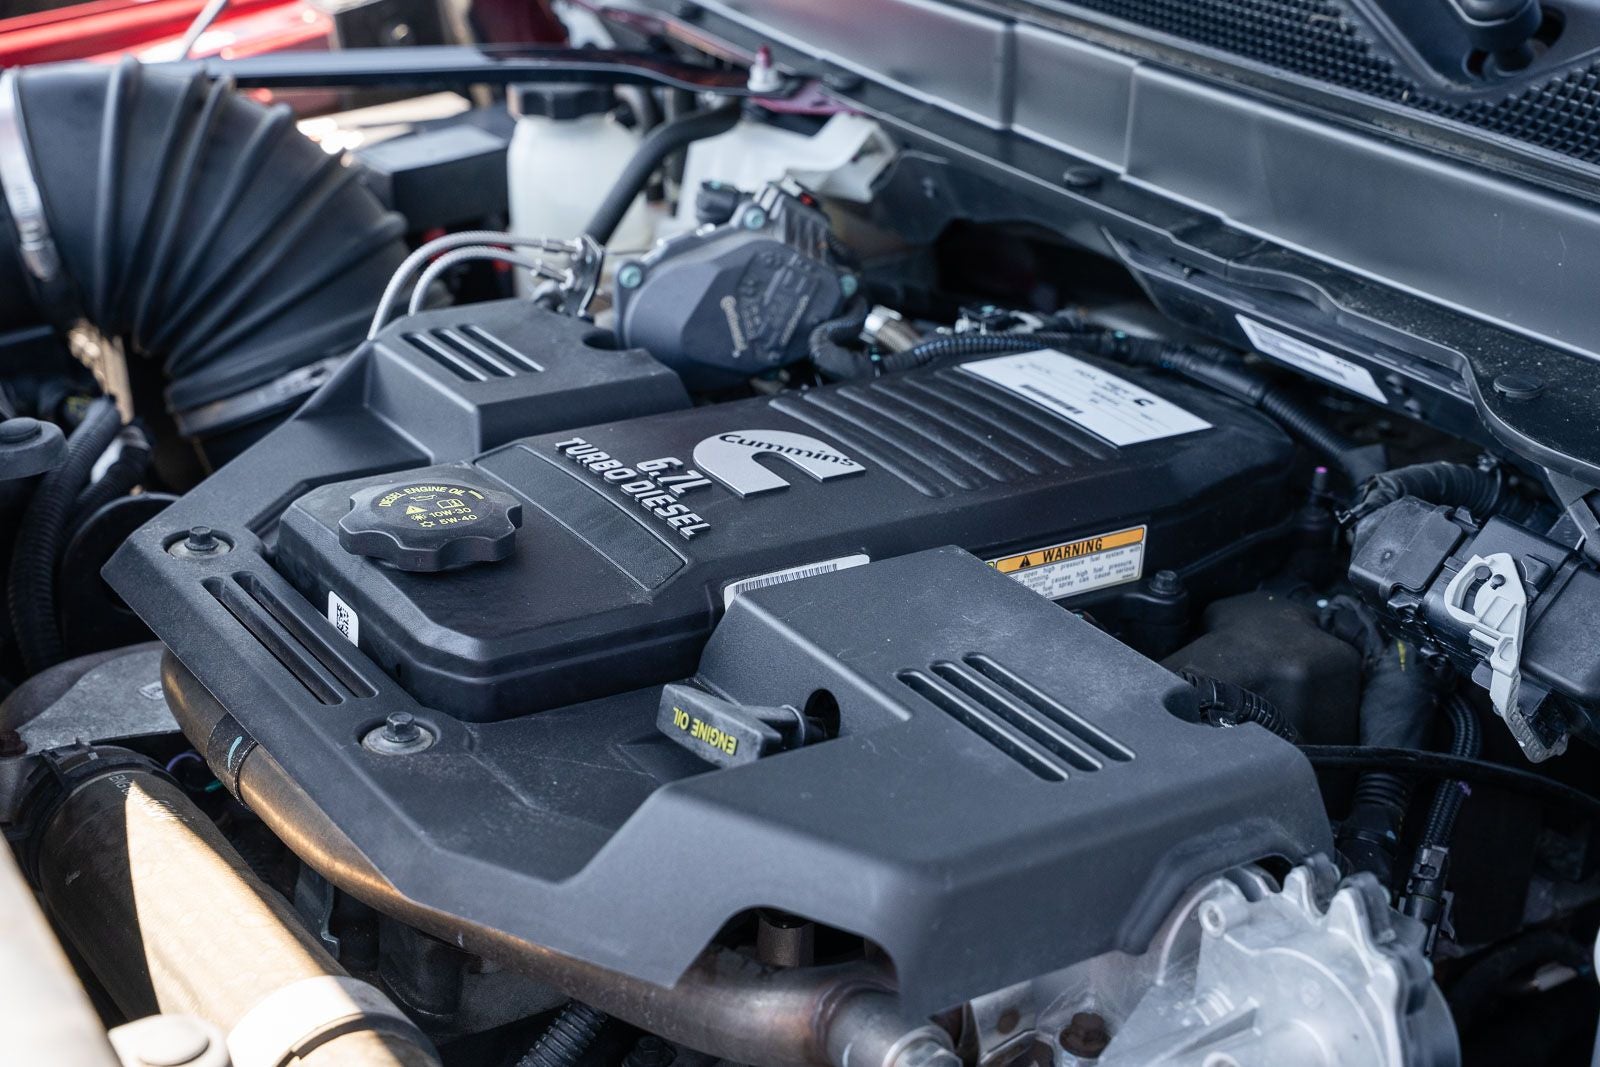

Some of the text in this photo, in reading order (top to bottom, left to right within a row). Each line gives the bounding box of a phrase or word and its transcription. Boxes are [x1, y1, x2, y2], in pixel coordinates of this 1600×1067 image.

[718, 434, 855, 467] Cummins
[555, 437, 711, 540] TURBO DIESEL
[636, 456, 712, 497] 6.7L
[379, 486, 466, 506] DIESEL ENGINE OIL
[429, 507, 472, 518] 10W-30
[439, 514, 478, 525] 5W-40
[1042, 538, 1103, 563] WARNING
[673, 707, 737, 756] ENGINE OIL
